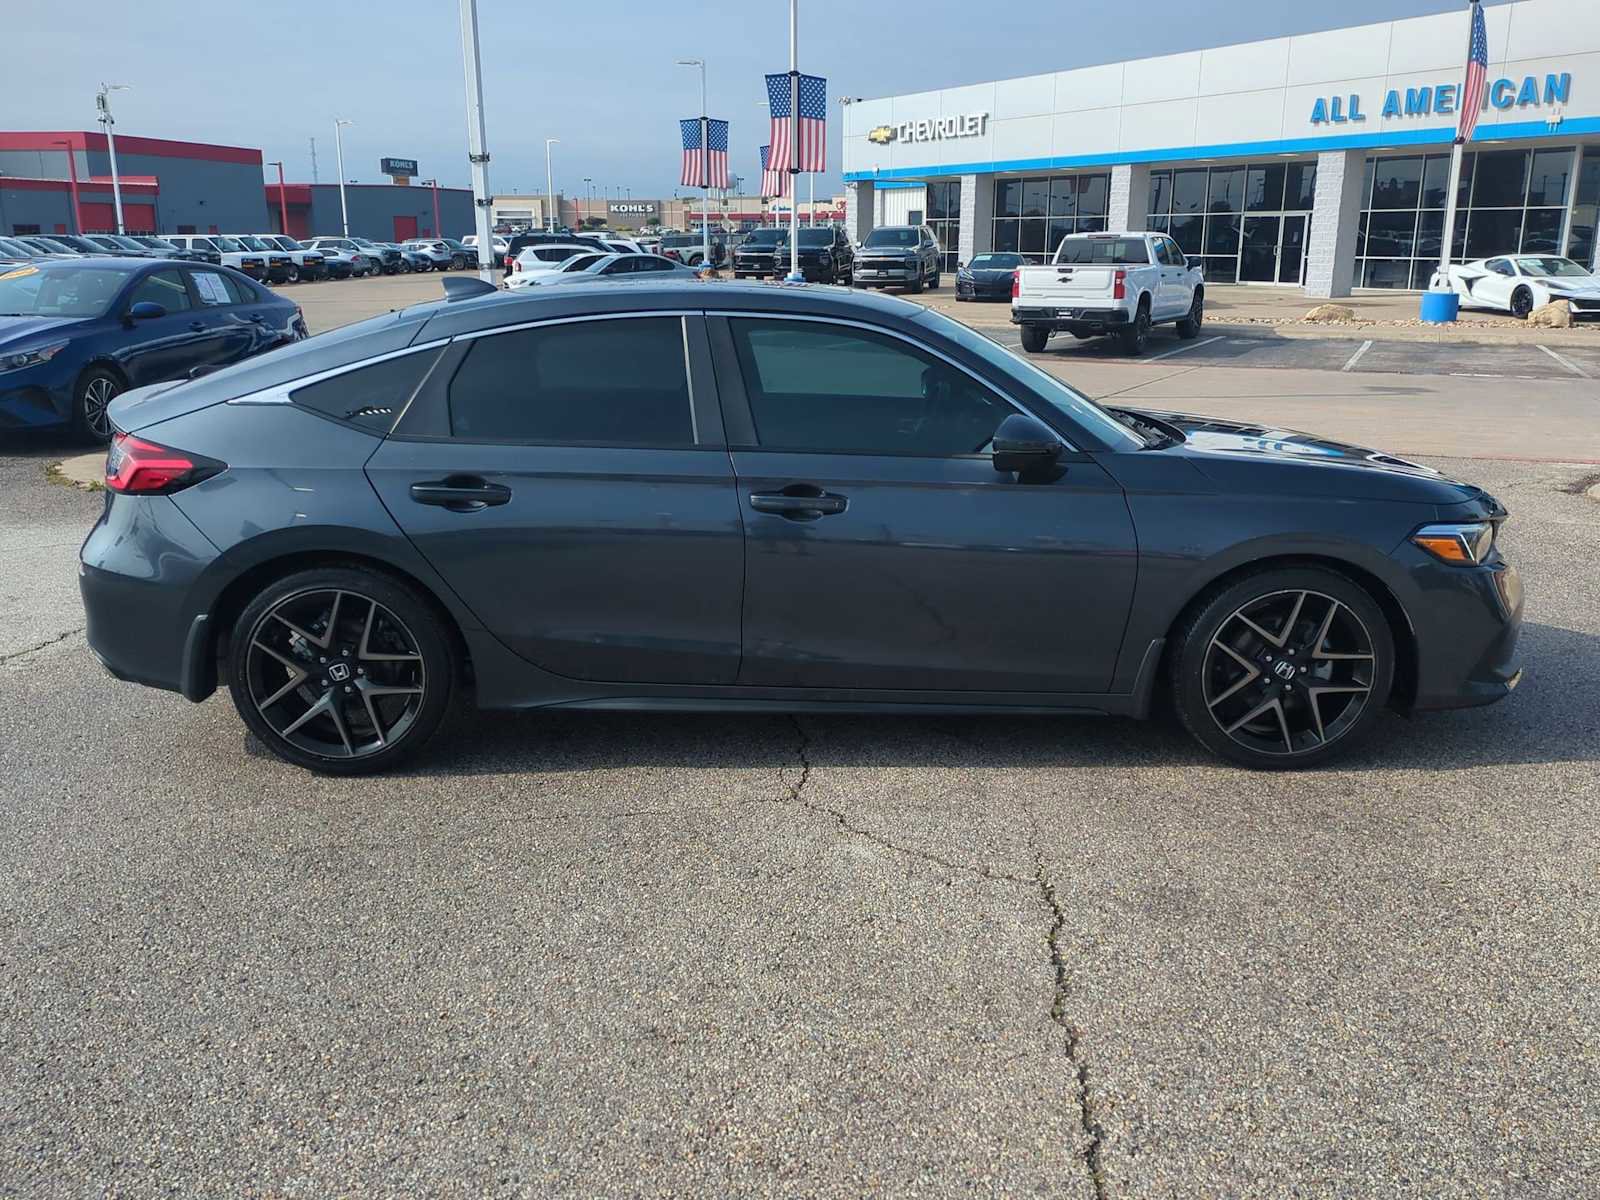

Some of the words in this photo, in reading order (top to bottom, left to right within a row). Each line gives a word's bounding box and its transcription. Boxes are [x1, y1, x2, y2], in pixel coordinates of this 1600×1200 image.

[1311, 95, 1366, 124] ALL
[1382, 73, 1572, 118] AMECAN
[897, 113, 988, 143] CHEVROLET
[610, 204, 654, 212] KOHL'S
